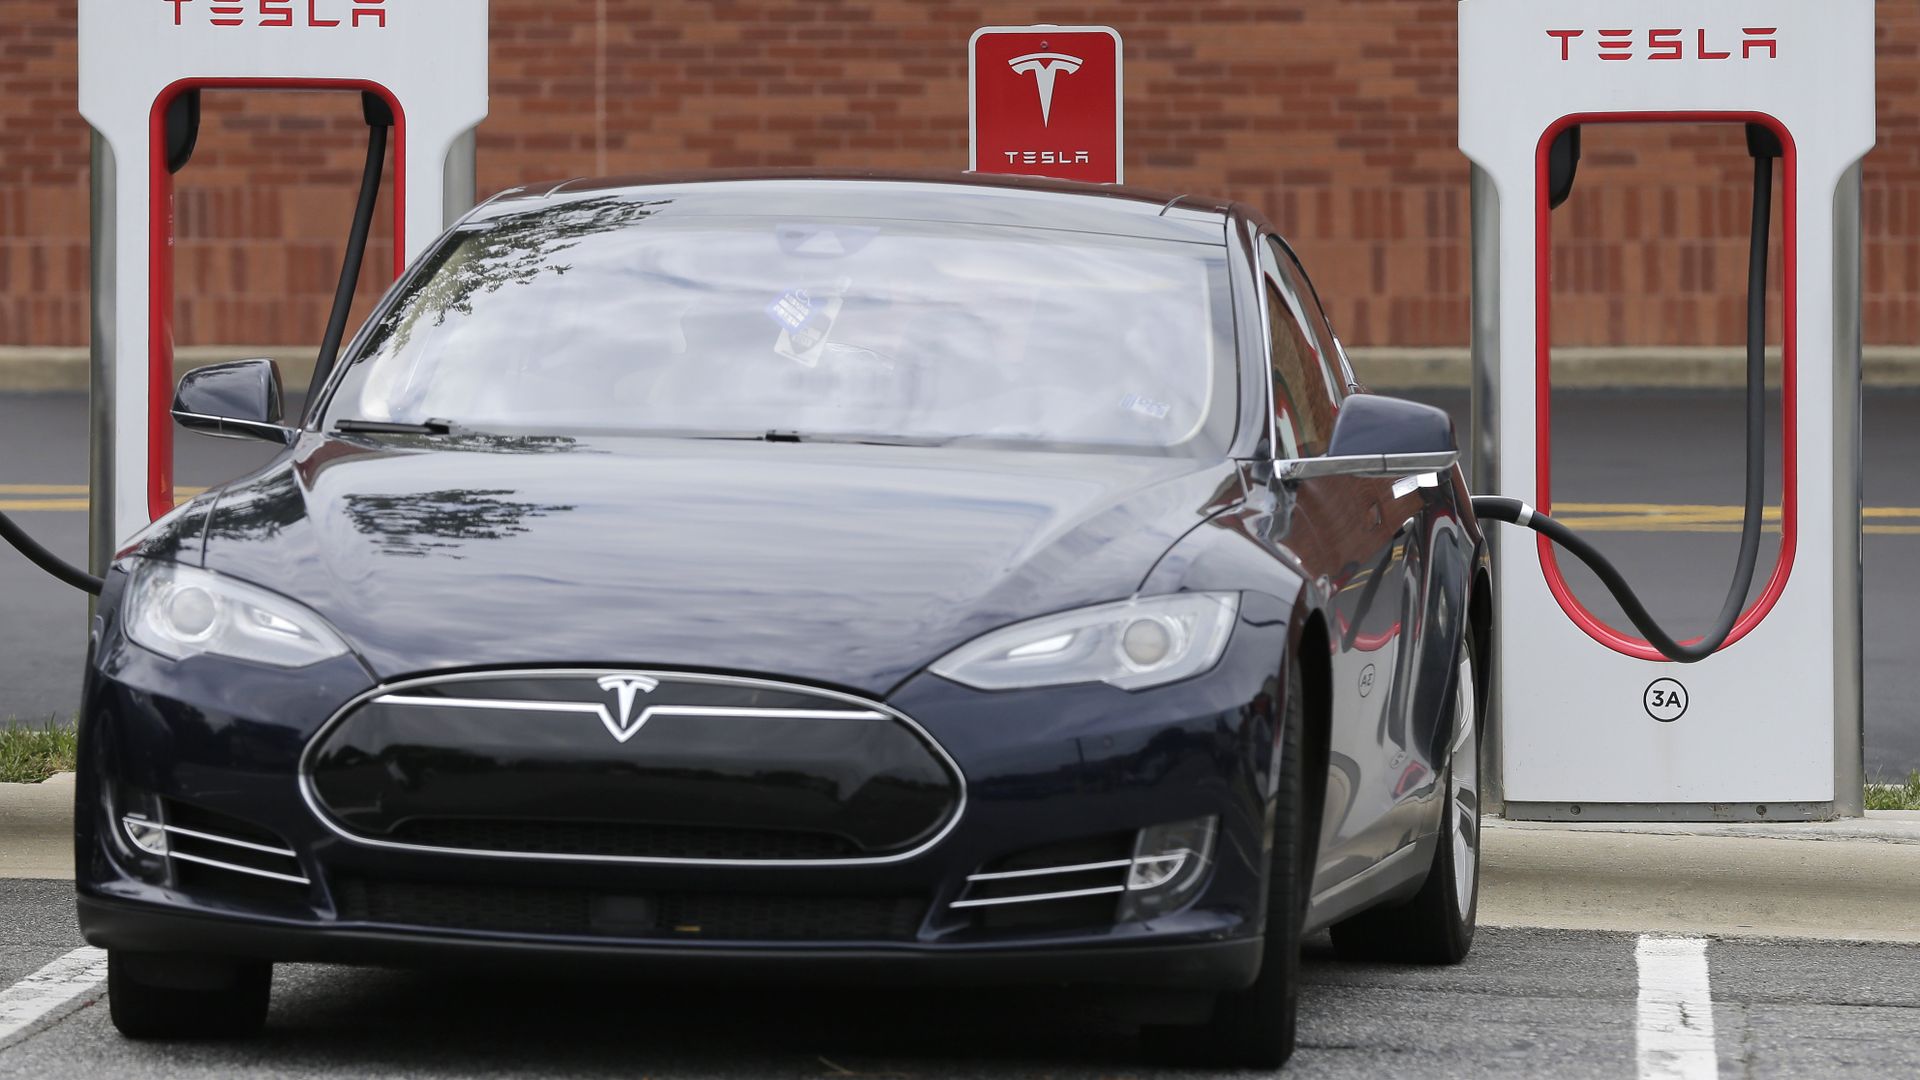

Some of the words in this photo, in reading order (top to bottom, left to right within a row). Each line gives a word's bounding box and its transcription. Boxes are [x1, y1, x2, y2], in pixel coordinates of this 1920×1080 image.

[163, 0, 386, 28] TESLA
[1545, 27, 1777, 61] TESLA
[1004, 151, 1089, 164] TESLA
[1651, 690, 1682, 708] 3A
